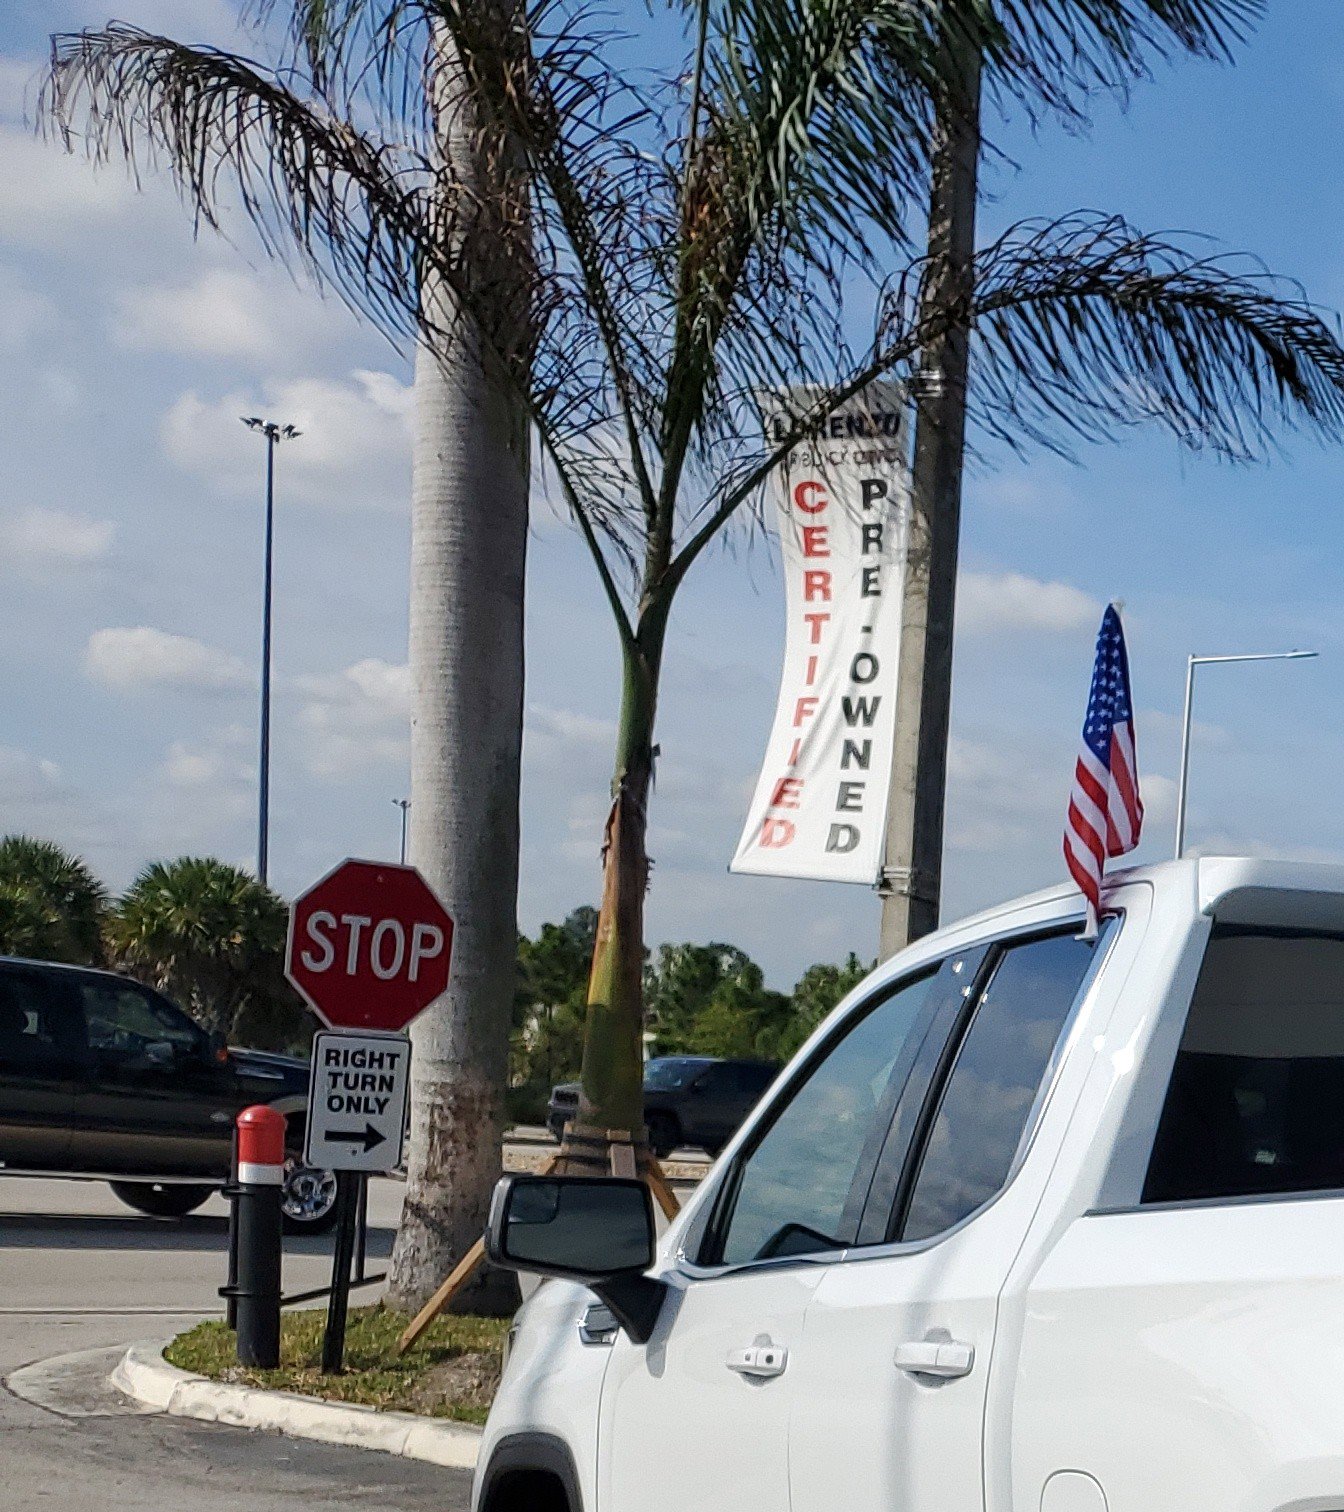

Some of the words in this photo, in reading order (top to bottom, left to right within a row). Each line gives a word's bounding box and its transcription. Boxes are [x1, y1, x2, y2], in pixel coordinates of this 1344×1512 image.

[760, 480, 831, 849] CERTIFIED
[826, 478, 888, 854] PRE-OWNED
[301, 910, 444, 982] STOP
[324, 1047, 401, 1071] RIGHT
[328, 1071, 394, 1093] TURN
[326, 1094, 390, 1116] ONLY
